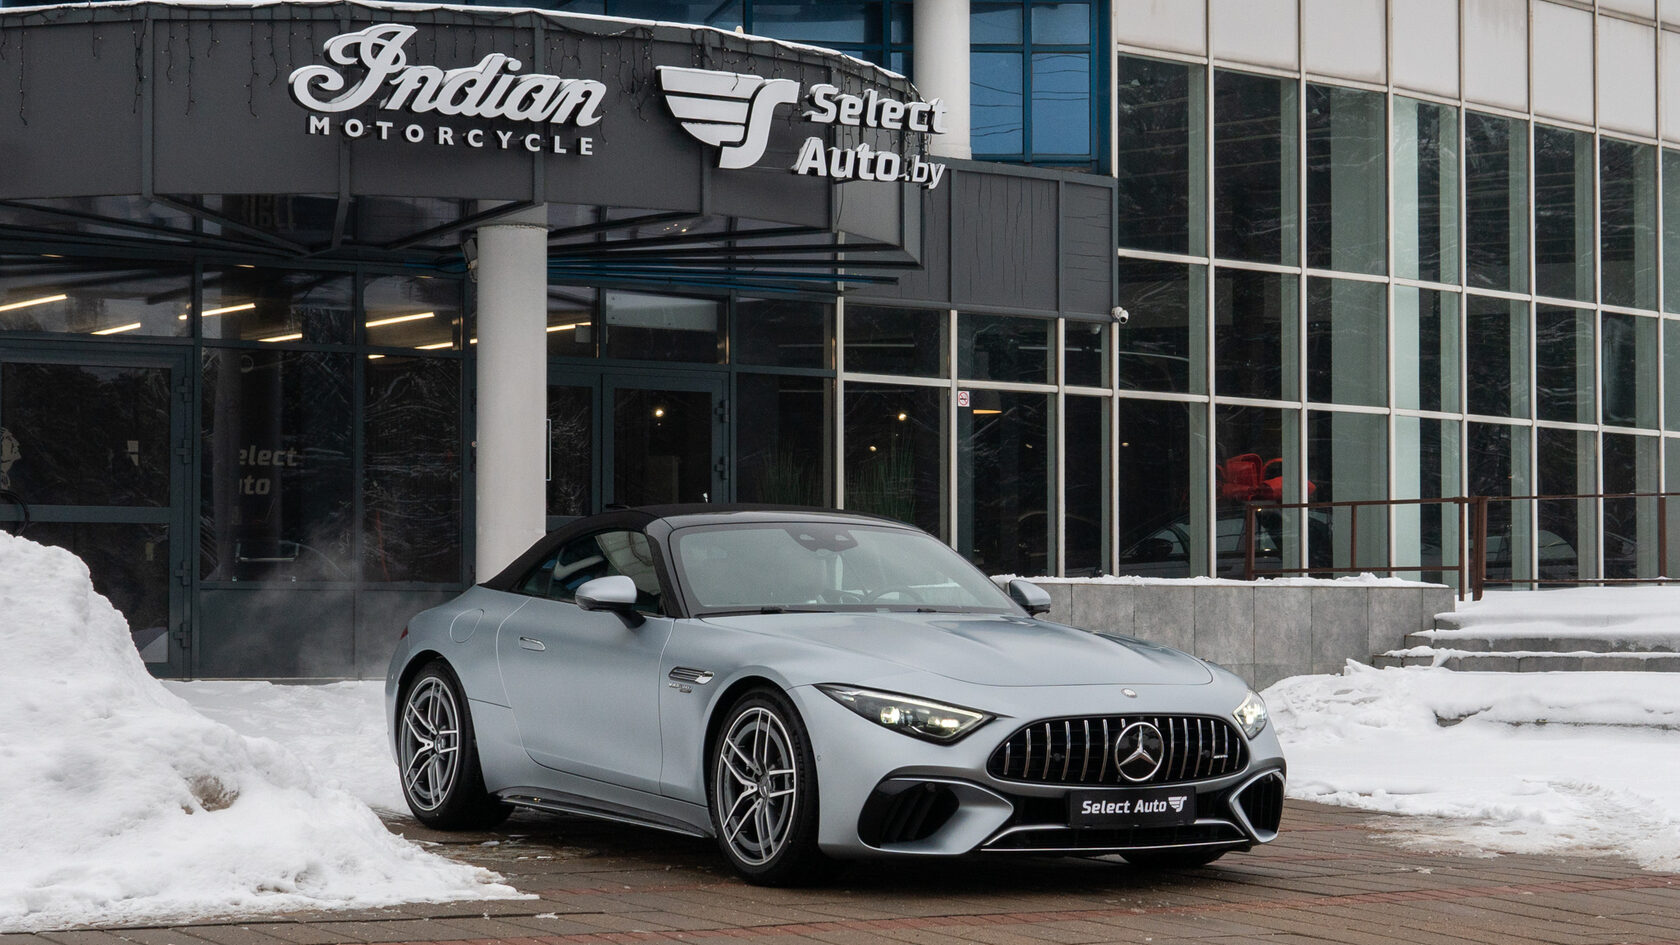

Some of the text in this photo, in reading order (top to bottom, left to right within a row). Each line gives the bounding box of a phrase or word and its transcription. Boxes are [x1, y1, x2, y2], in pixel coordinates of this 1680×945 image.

[289, 23, 606, 127] Indian
[804, 84, 947, 134] Select
[309, 115, 593, 156] MOTORCYCLE
[792, 137, 945, 190] Auto.by
[240, 445, 297, 467] elect
[1081, 799, 1167, 814] Select Auto
